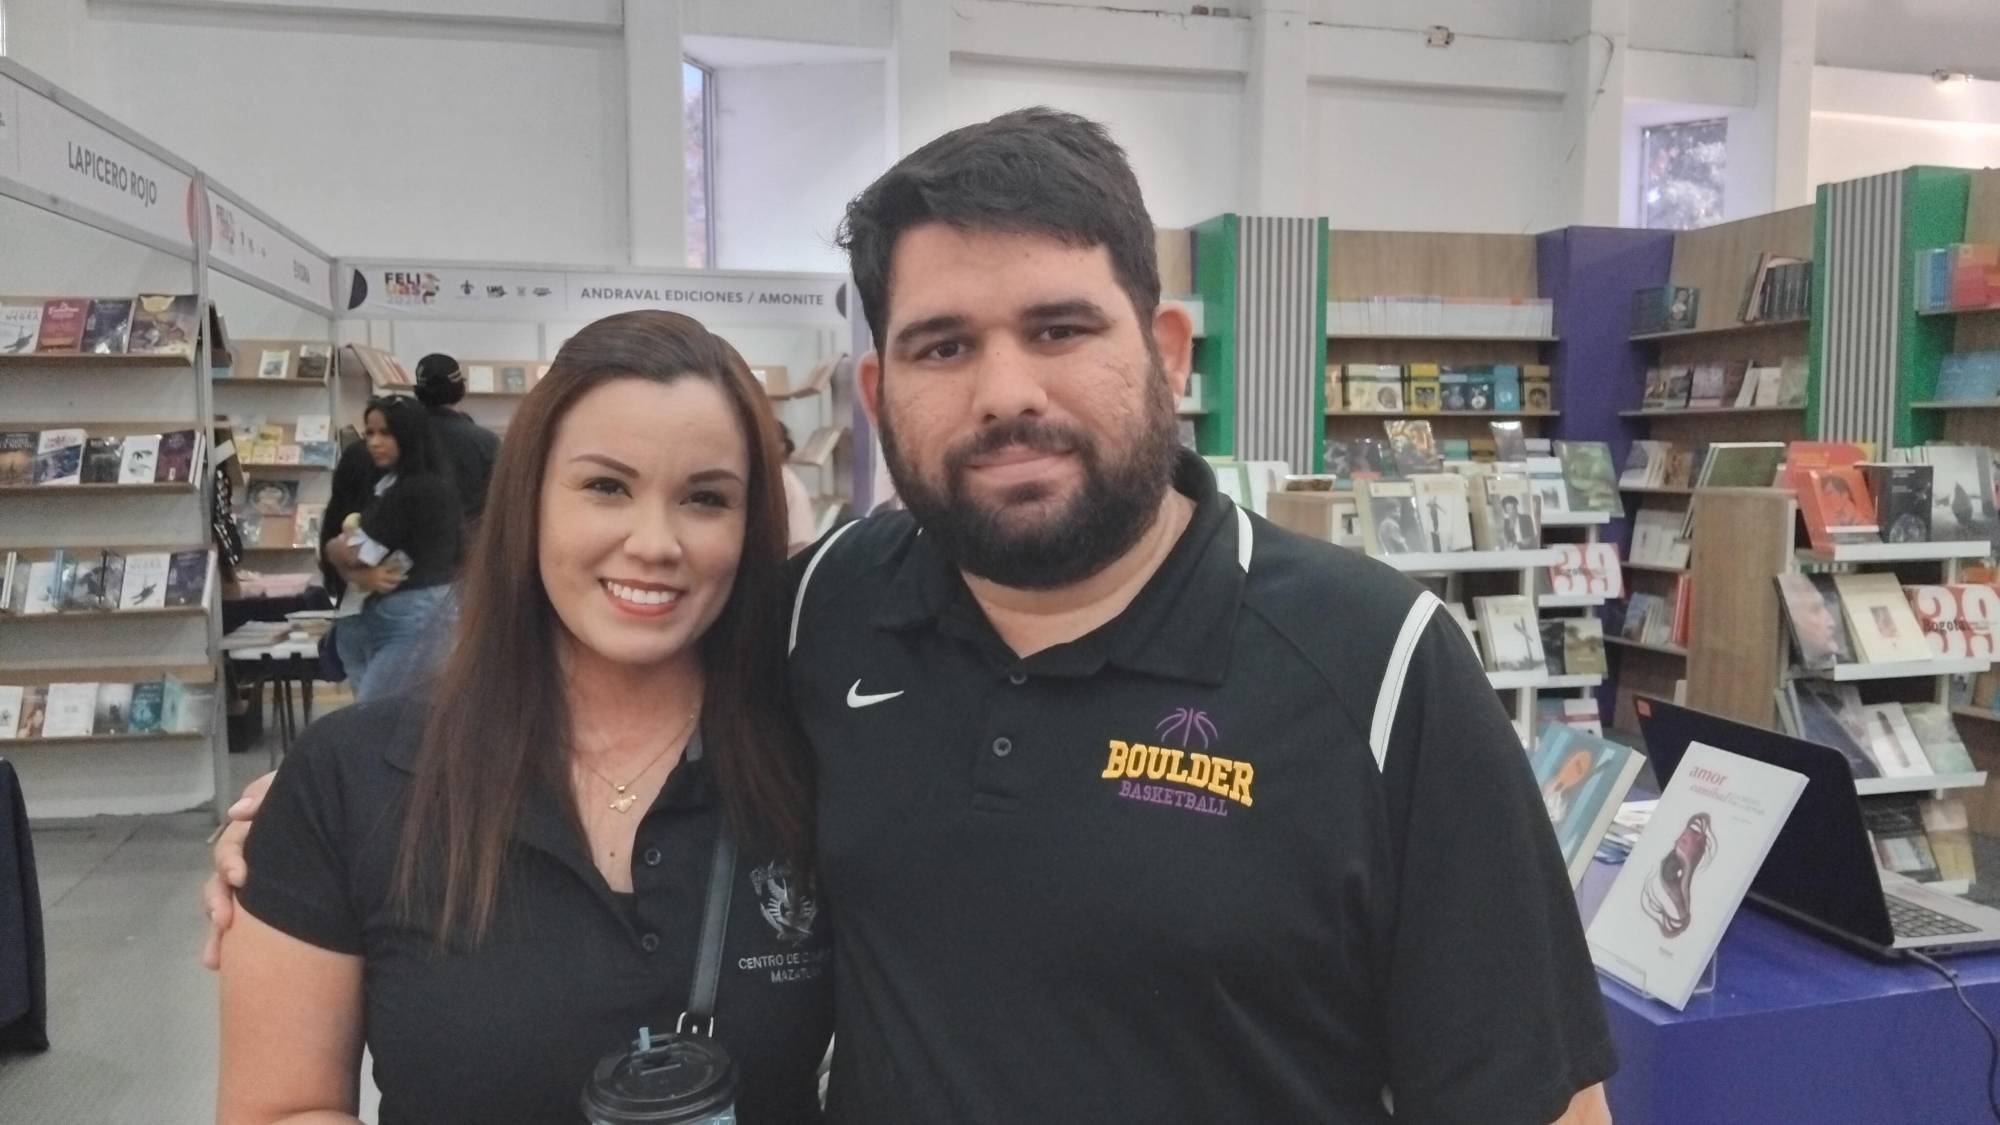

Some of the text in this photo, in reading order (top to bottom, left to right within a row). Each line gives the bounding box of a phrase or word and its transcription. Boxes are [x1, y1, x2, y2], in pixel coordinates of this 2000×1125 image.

[68, 141, 157, 207] LAPICERO ROJO
[385, 272, 421, 284] FELI
[581, 288, 661, 301] ANDRAVAL
[665, 289, 743, 303] EDICIONES
[758, 293, 824, 305] AMONITE
[1101, 739, 1254, 807] BOULDER
[1689, 766, 1728, 786] amor
[1118, 780, 1228, 816] BASKETBALL
[738, 954, 784, 969] CENTRO
[786, 952, 800, 965] DE
[770, 967, 823, 983] MAZATL
